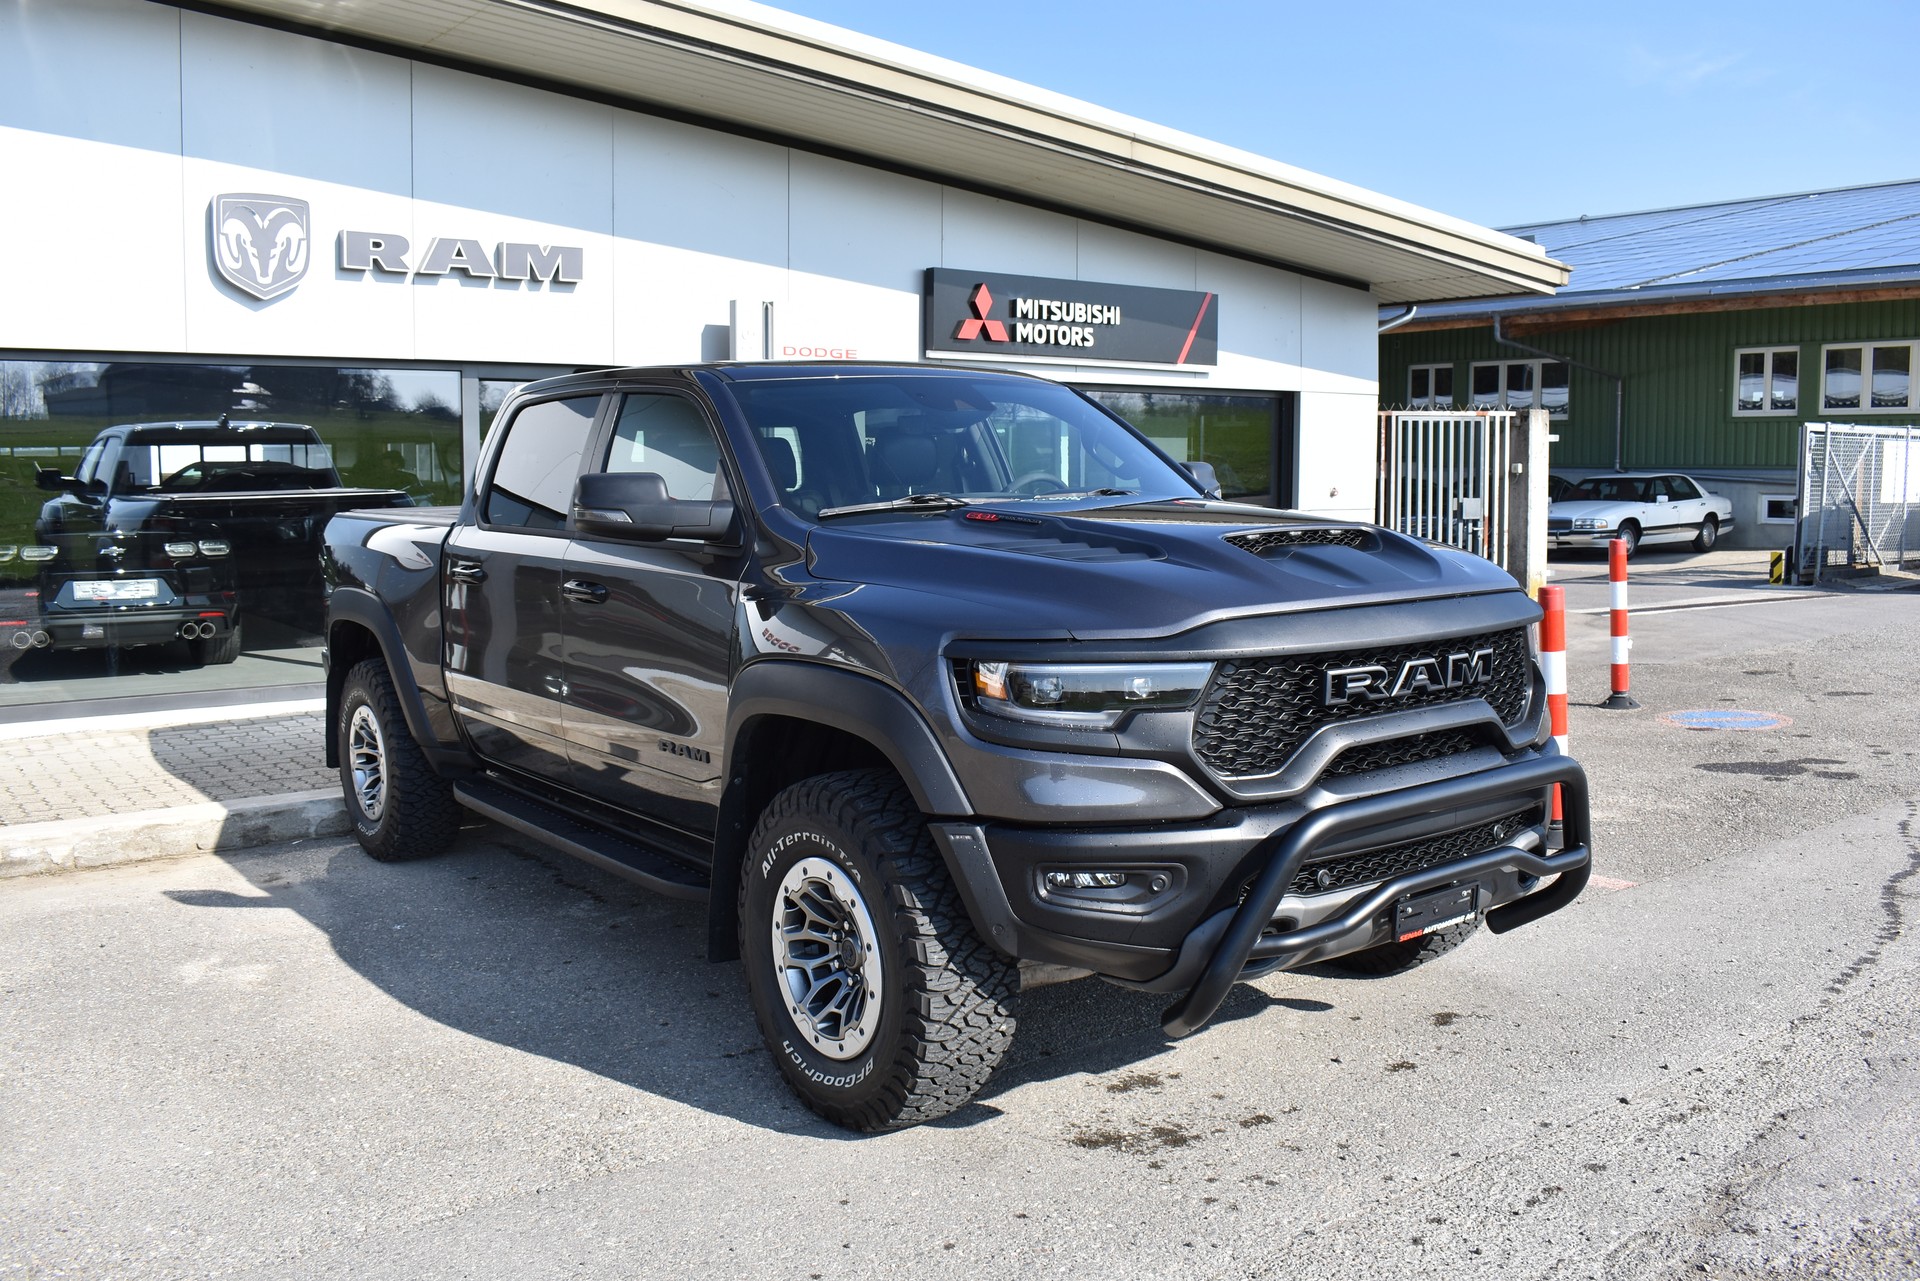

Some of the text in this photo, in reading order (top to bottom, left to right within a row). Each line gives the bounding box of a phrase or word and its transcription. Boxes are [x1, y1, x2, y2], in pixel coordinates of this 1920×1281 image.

[339, 230, 583, 282] RAM
[1016, 298, 1121, 325] MITSUBISHI
[783, 346, 858, 359] DODGE
[1016, 322, 1094, 347] MOTORS
[1325, 648, 1493, 705] RAM
[658, 739, 711, 764] RAM
[761, 831, 862, 882] All-Terrain T/A
[782, 1040, 875, 1088] BFGoodrich
